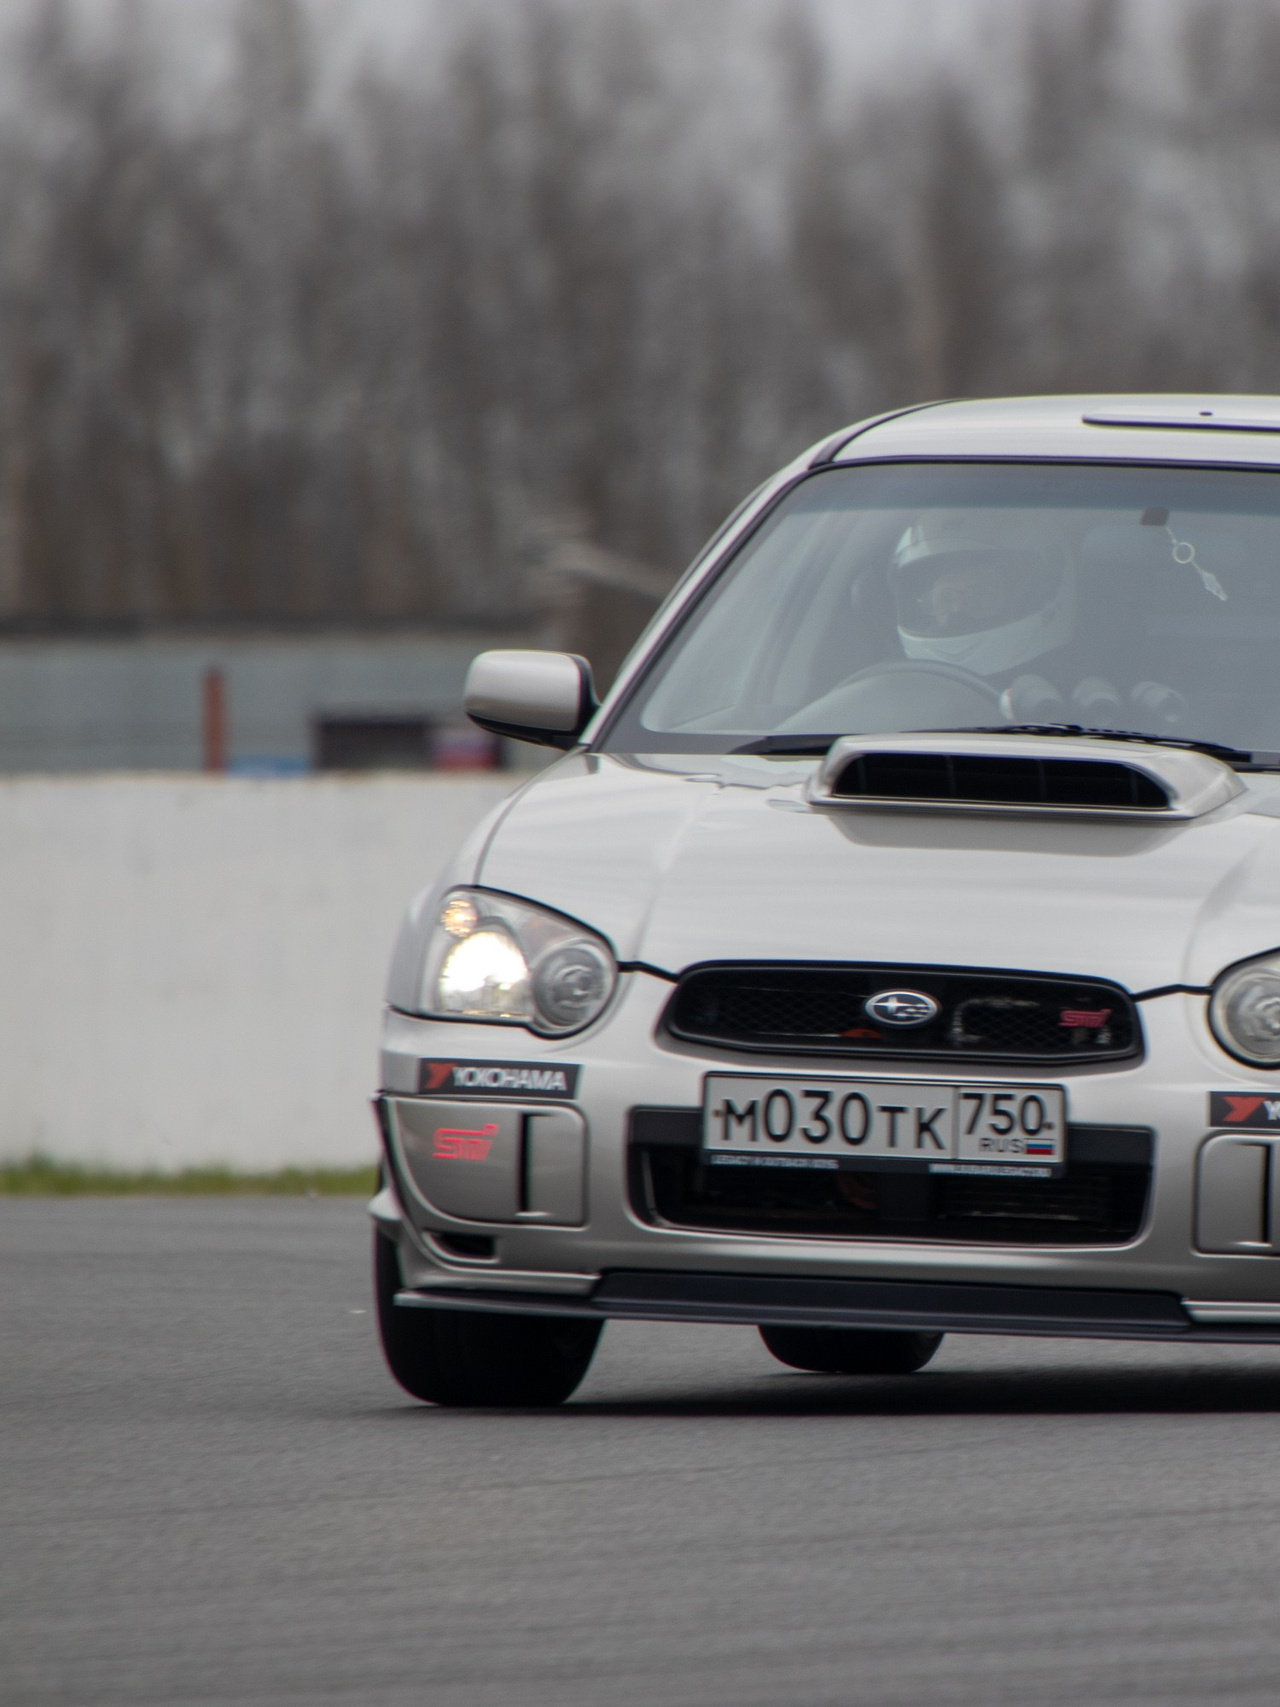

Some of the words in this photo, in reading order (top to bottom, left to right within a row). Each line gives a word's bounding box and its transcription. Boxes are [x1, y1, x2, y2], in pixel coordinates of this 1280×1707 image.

[452, 1066, 568, 1091] YOKOHAMA
[962, 1091, 1047, 1136] 750
[978, 1137, 1025, 1154] RUS
